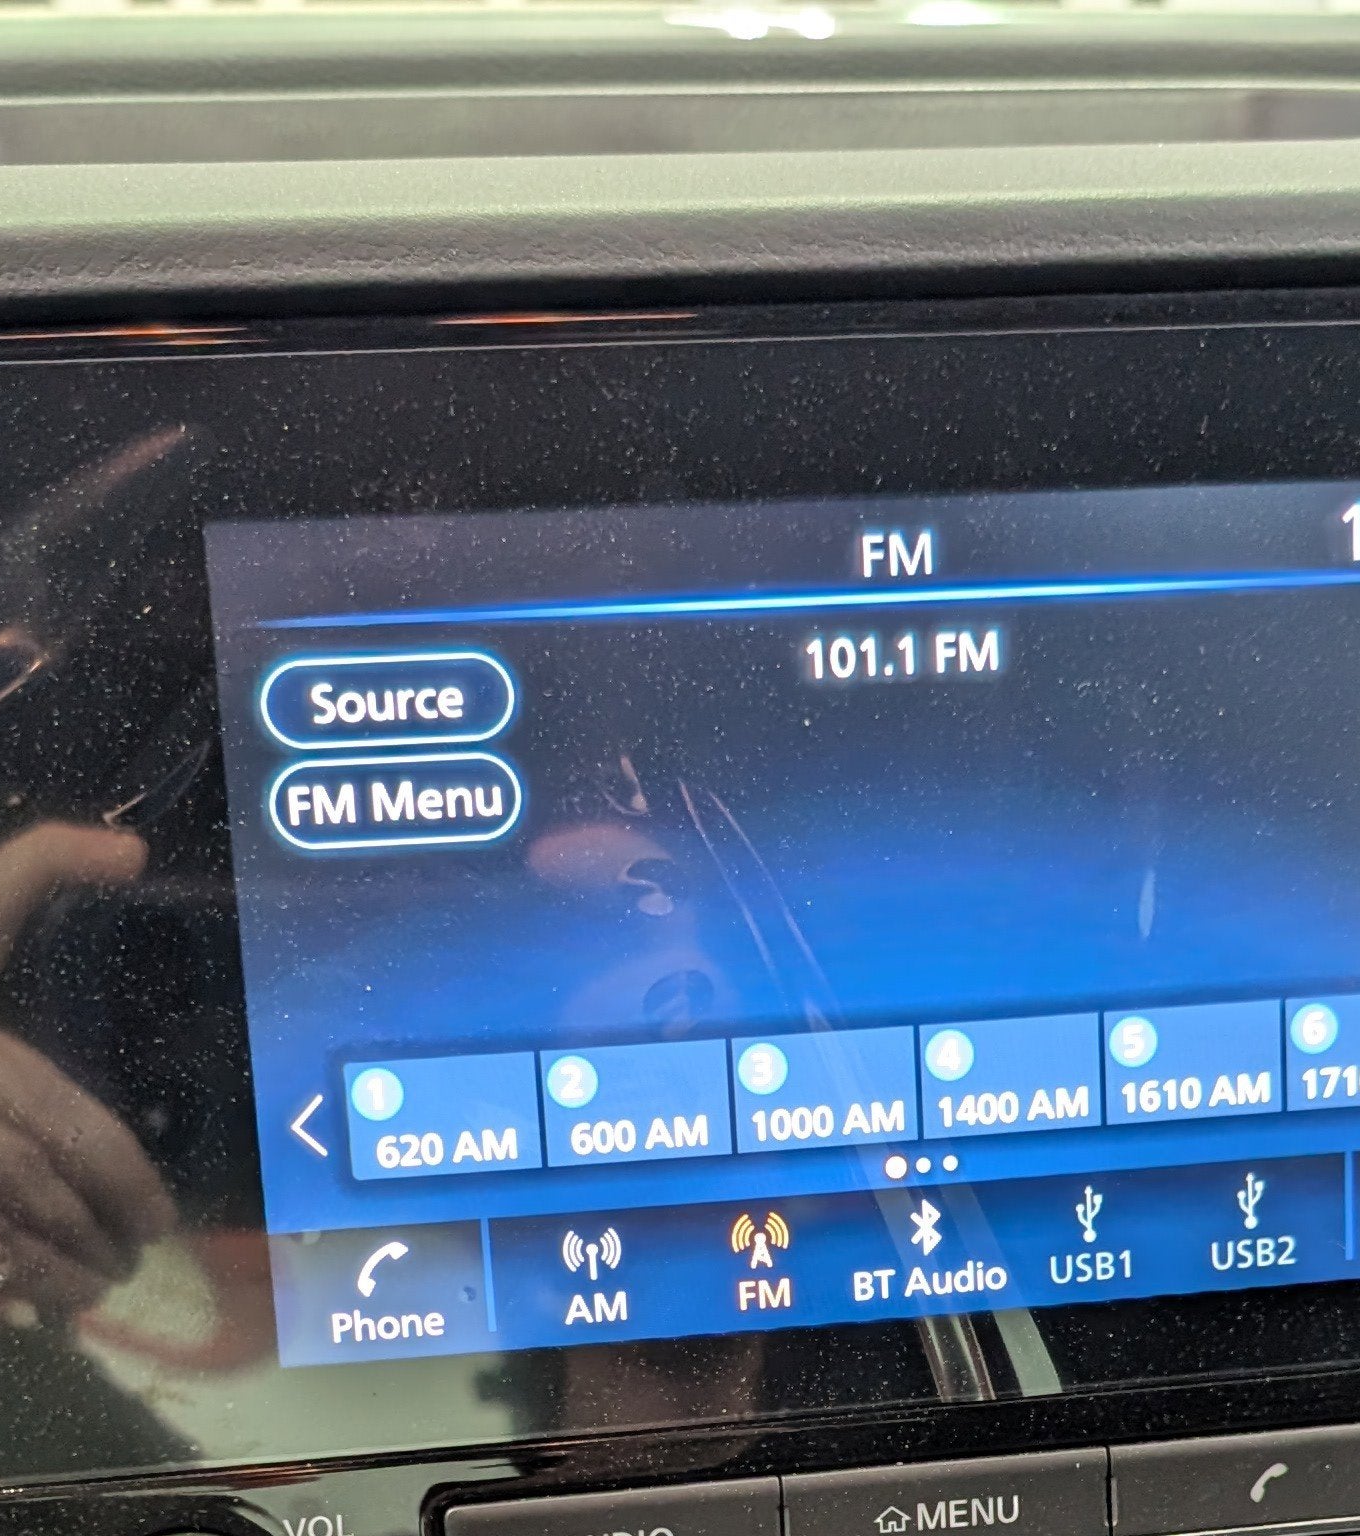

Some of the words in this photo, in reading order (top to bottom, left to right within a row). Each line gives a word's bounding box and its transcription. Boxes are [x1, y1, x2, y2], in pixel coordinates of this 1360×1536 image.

[861, 531, 934, 578] FM
[806, 634, 915, 680] 101.1
[935, 631, 1000, 674] FM
[310, 683, 464, 725] Source
[289, 784, 356, 826] FM
[372, 780, 502, 822] Menu
[938, 1095, 1019, 1128] 1400
[1027, 1087, 1090, 1120] AM
[1122, 1079, 1202, 1113] 1610
[1209, 1072, 1272, 1106] AM
[571, 1120, 635, 1156] 600
[645, 1115, 709, 1150] AM
[751, 1106, 833, 1141] 1000
[841, 1101, 905, 1135] AM
[376, 1132, 443, 1169] 620
[452, 1129, 518, 1164] AM
[1050, 1250, 1132, 1285] USB1
[1211, 1236, 1296, 1270] USB2
[739, 1279, 790, 1310] FM
[854, 1269, 896, 1302] BT
[904, 1263, 1008, 1296] Audio
[332, 1311, 444, 1344] Phone
[565, 1292, 628, 1325] AM
[917, 1496, 1020, 1532] MENU
